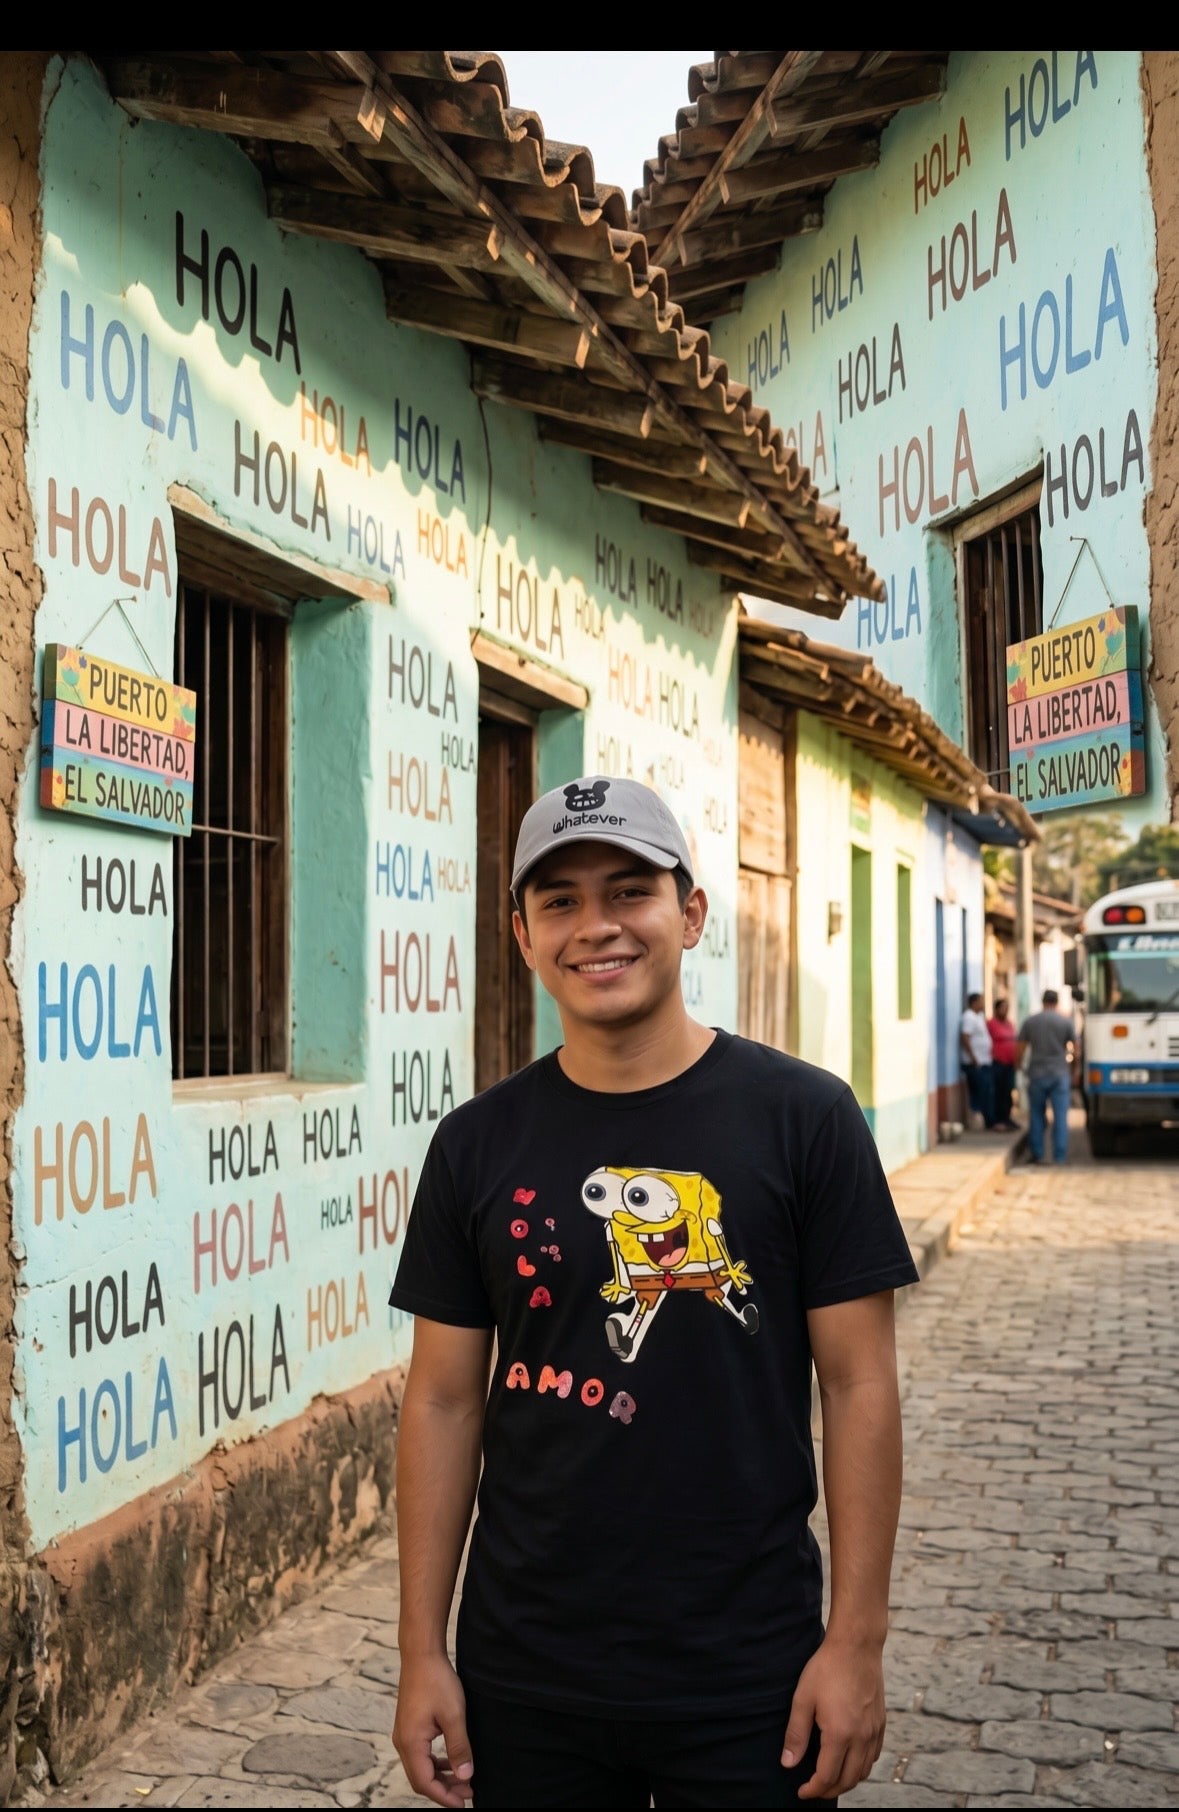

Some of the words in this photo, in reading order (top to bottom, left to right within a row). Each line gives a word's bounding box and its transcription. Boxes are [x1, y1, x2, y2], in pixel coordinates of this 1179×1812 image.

[914, 116, 971, 215] HOLA
[176, 210, 301, 375] HOLA
[812, 234, 863, 334] HOLA
[928, 188, 1017, 322] HOLA
[60, 290, 197, 451] HOLA
[748, 309, 791, 393] HOLA
[1000, 247, 1130, 412] HOLA
[838, 322, 906, 425] HOLA
[300, 380, 371, 477] HOLA
[395, 398, 466, 504] HOLA
[1046, 408, 1144, 528] HOLA
[234, 419, 331, 542] HOLA
[878, 407, 979, 538] HOLA
[48, 477, 172, 598] HOLA
[348, 504, 406, 580] HOLA
[417, 508, 468, 580] HOLA
[596, 532, 638, 609] HOLA
[497, 553, 564, 660] HOLA
[647, 557, 684, 626] HOLA
[857, 566, 922, 649] HOLA
[90, 663, 167, 721] PUERTO
[388, 634, 458, 723] HOLA
[609, 643, 654, 721] HOLA
[1031, 626, 1095, 686] PUERTO
[66, 709, 91, 749] LA
[100, 718, 189, 780] LIBERTAD,
[659, 671, 700, 742] HOLA
[1014, 705, 1033, 744] LA
[1037, 680, 1121, 739] LIBERTAD,
[388, 750, 453, 825] HOLA
[442, 731, 476, 774] HOLA
[1016, 763, 1033, 803] EL
[1038, 742, 1121, 799] SALVADOR
[65, 765, 88, 803] EL
[95, 772, 185, 825] SALVADOR
[82, 854, 167, 917] HOLA
[376, 840, 434, 903] HOLA
[438, 856, 471, 894] HOLA
[38, 961, 162, 1063] HOLA
[380, 929, 462, 1014] HOLA
[392, 1048, 455, 1126] HOLA
[34, 1112, 157, 1227] HOLA
[209, 1120, 279, 1185] HOLA
[303, 1104, 362, 1164] HOLA
[193, 1192, 290, 1294] HOLA
[321, 1194, 353, 1230] HOLA
[358, 1166, 409, 1256] HOL
[69, 1262, 165, 1358] HOLA
[307, 1271, 370, 1353] HOLA
[199, 1303, 290, 1438] HOLA
[506, 1362, 637, 1425] AMOR
[57, 1356, 177, 1493] HOLA
